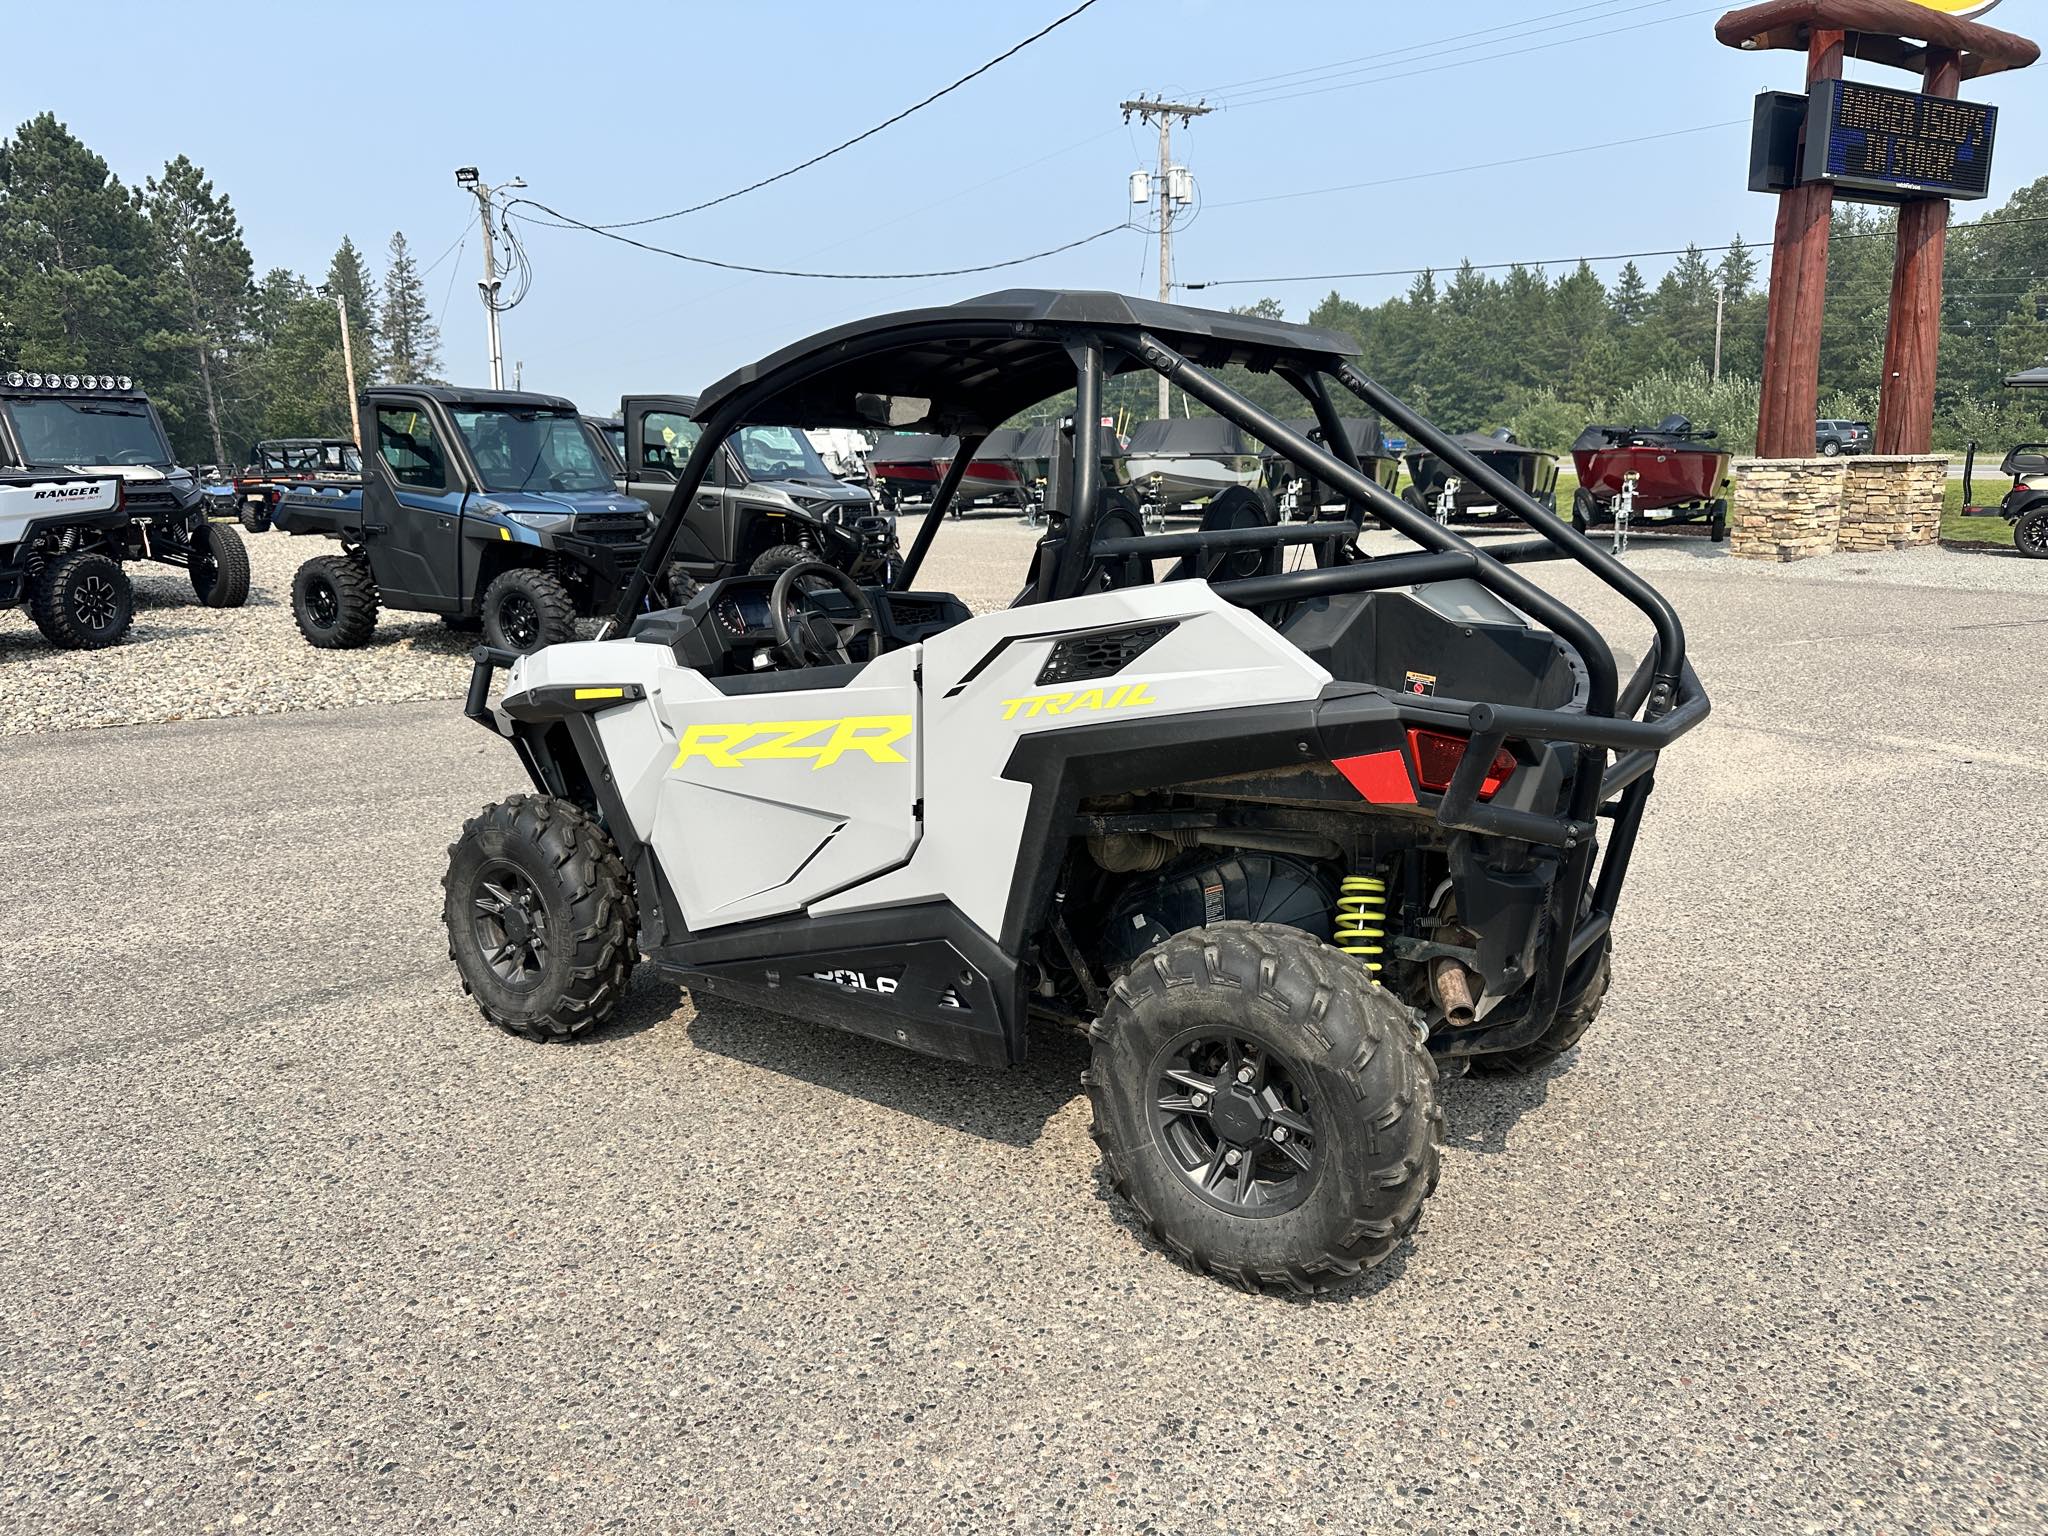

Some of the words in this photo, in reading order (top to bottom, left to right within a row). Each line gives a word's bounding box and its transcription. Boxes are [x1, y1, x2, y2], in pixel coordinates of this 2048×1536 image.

[1840, 87, 1915, 136] RANGER
[1863, 133, 1889, 172] IN
[34, 487, 100, 500] RANGER
[1001, 683, 1157, 721] TRAIL
[672, 714, 912, 770] RZR
